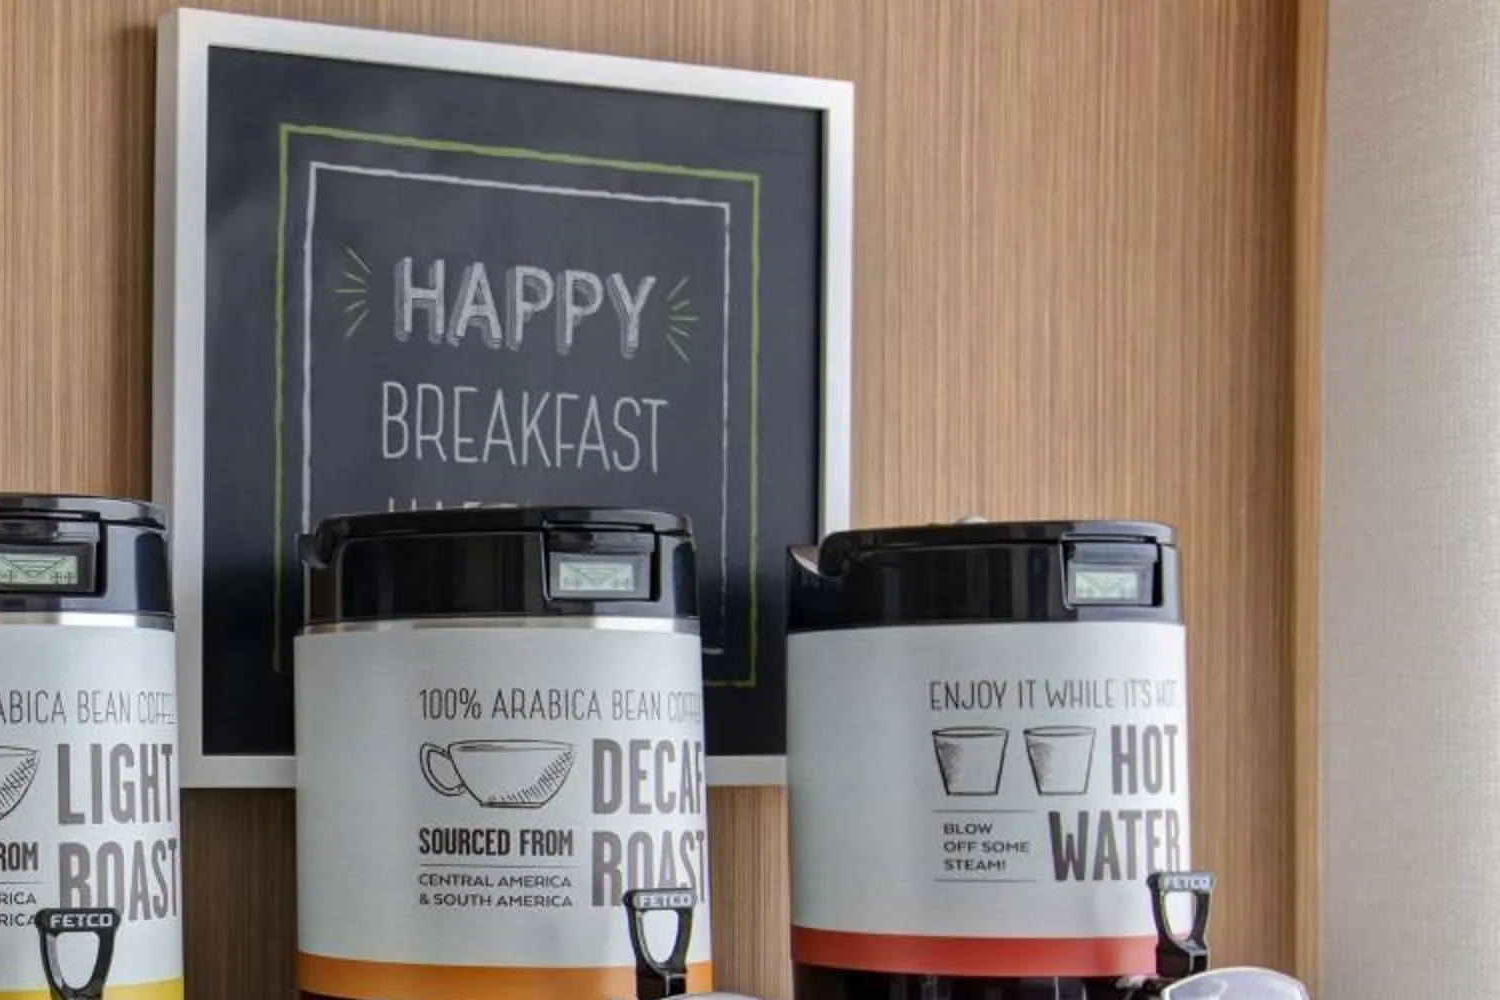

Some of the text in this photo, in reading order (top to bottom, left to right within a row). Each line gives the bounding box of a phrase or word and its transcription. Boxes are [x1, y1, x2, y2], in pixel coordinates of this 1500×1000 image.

[393, 256, 657, 360] HAPPY
[380, 380, 669, 474] BREAKFAST
[76, 690, 132, 724] BEAN
[419, 687, 482, 721] 100%
[491, 687, 602, 721] ARABICA
[611, 689, 661, 721] BEAN
[929, 680, 1007, 711] ENJOY
[1018, 680, 1037, 710] IT
[1045, 678, 1117, 710] WHILE
[1111, 724, 1179, 795] HOT
[57, 743, 174, 826] LIGHT
[592, 739, 703, 815] DECAF
[418, 827, 574, 856] SOURCED FROM
[943, 823, 994, 836] BLOW
[1048, 809, 1182, 882] WATER
[943, 841, 1030, 854] OFF SOME
[58, 838, 178, 921] ROAST
[418, 873, 572, 888] CENTRAL AMERICA
[592, 830, 706, 907] ROAST
[943, 858, 1006, 872] STEAM!
[419, 893, 574, 908] & SOUTH AMERICA
[639, 893, 693, 909] FETCO
[51, 912, 113, 929] FETCO
